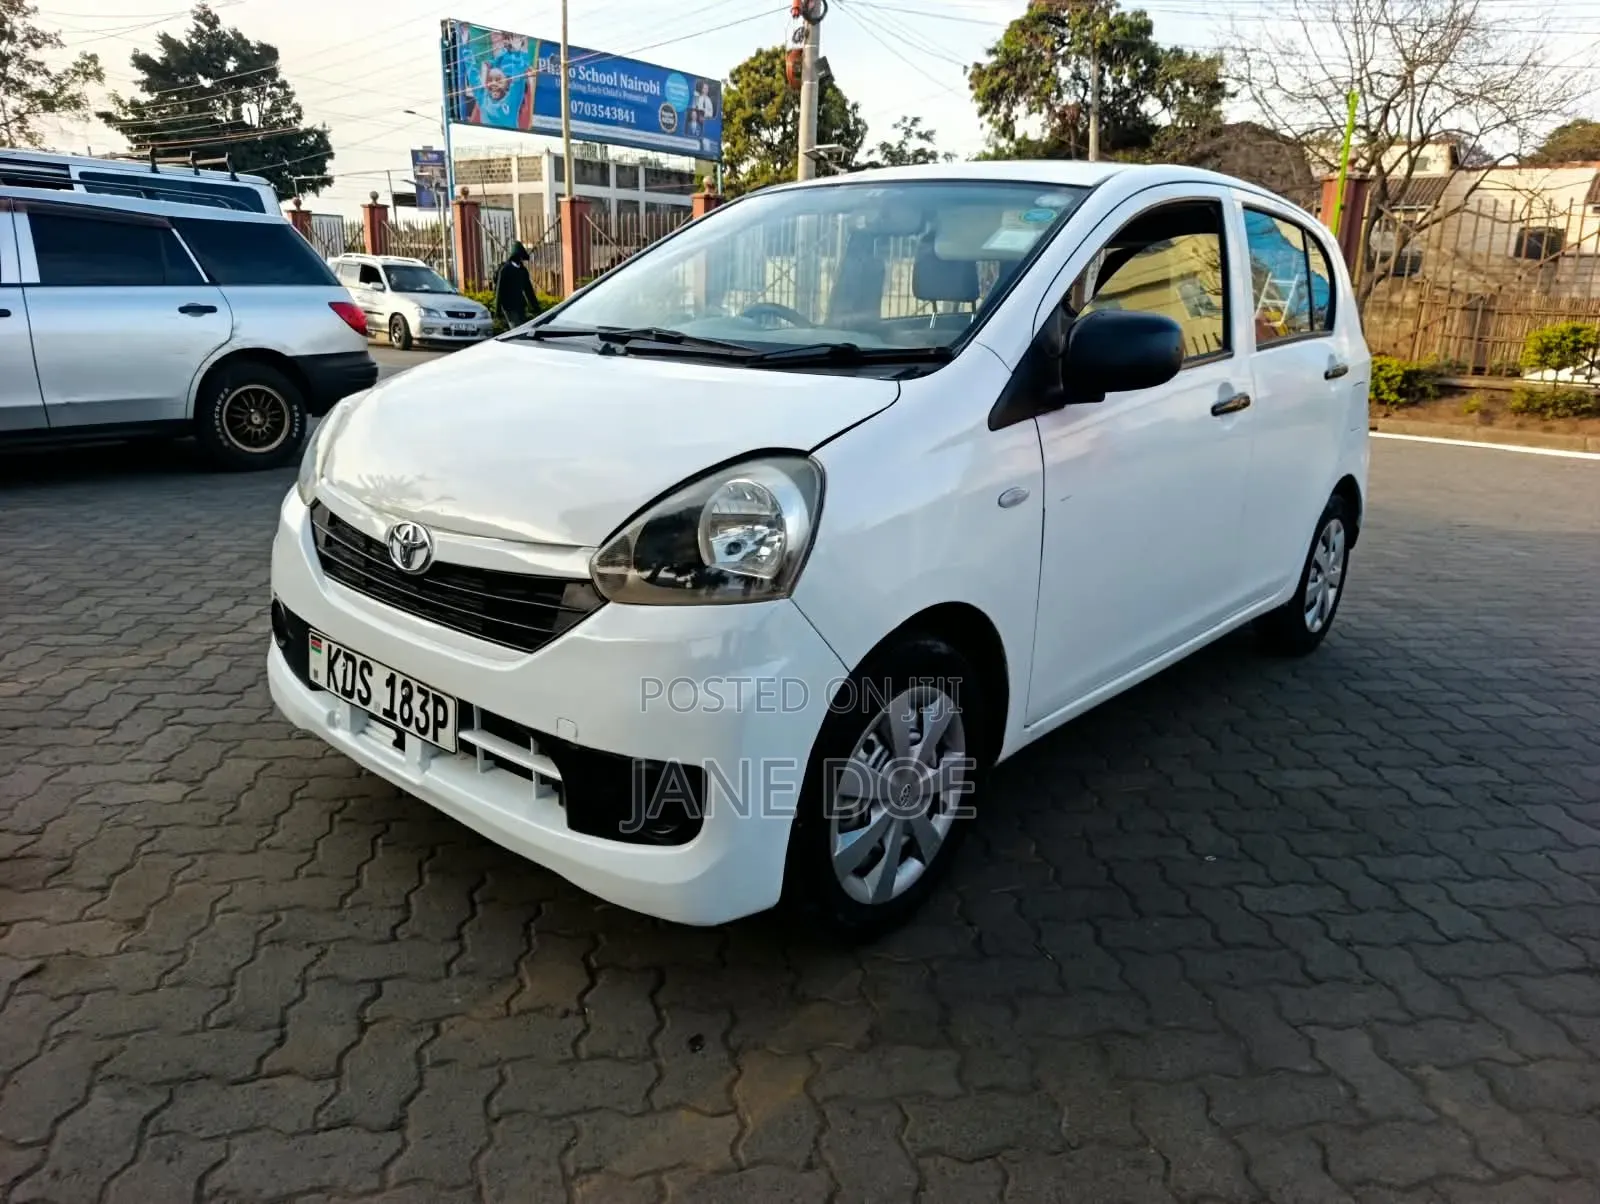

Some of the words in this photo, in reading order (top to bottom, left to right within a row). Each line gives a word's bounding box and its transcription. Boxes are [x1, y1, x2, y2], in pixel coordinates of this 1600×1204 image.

[538, 57, 576, 79] Phao
[578, 65, 617, 86] School
[620, 73, 660, 96] Nairobi
[571, 99, 636, 123] 0703543841
[327, 643, 373, 707] KDS
[382, 672, 448, 743] 183P
